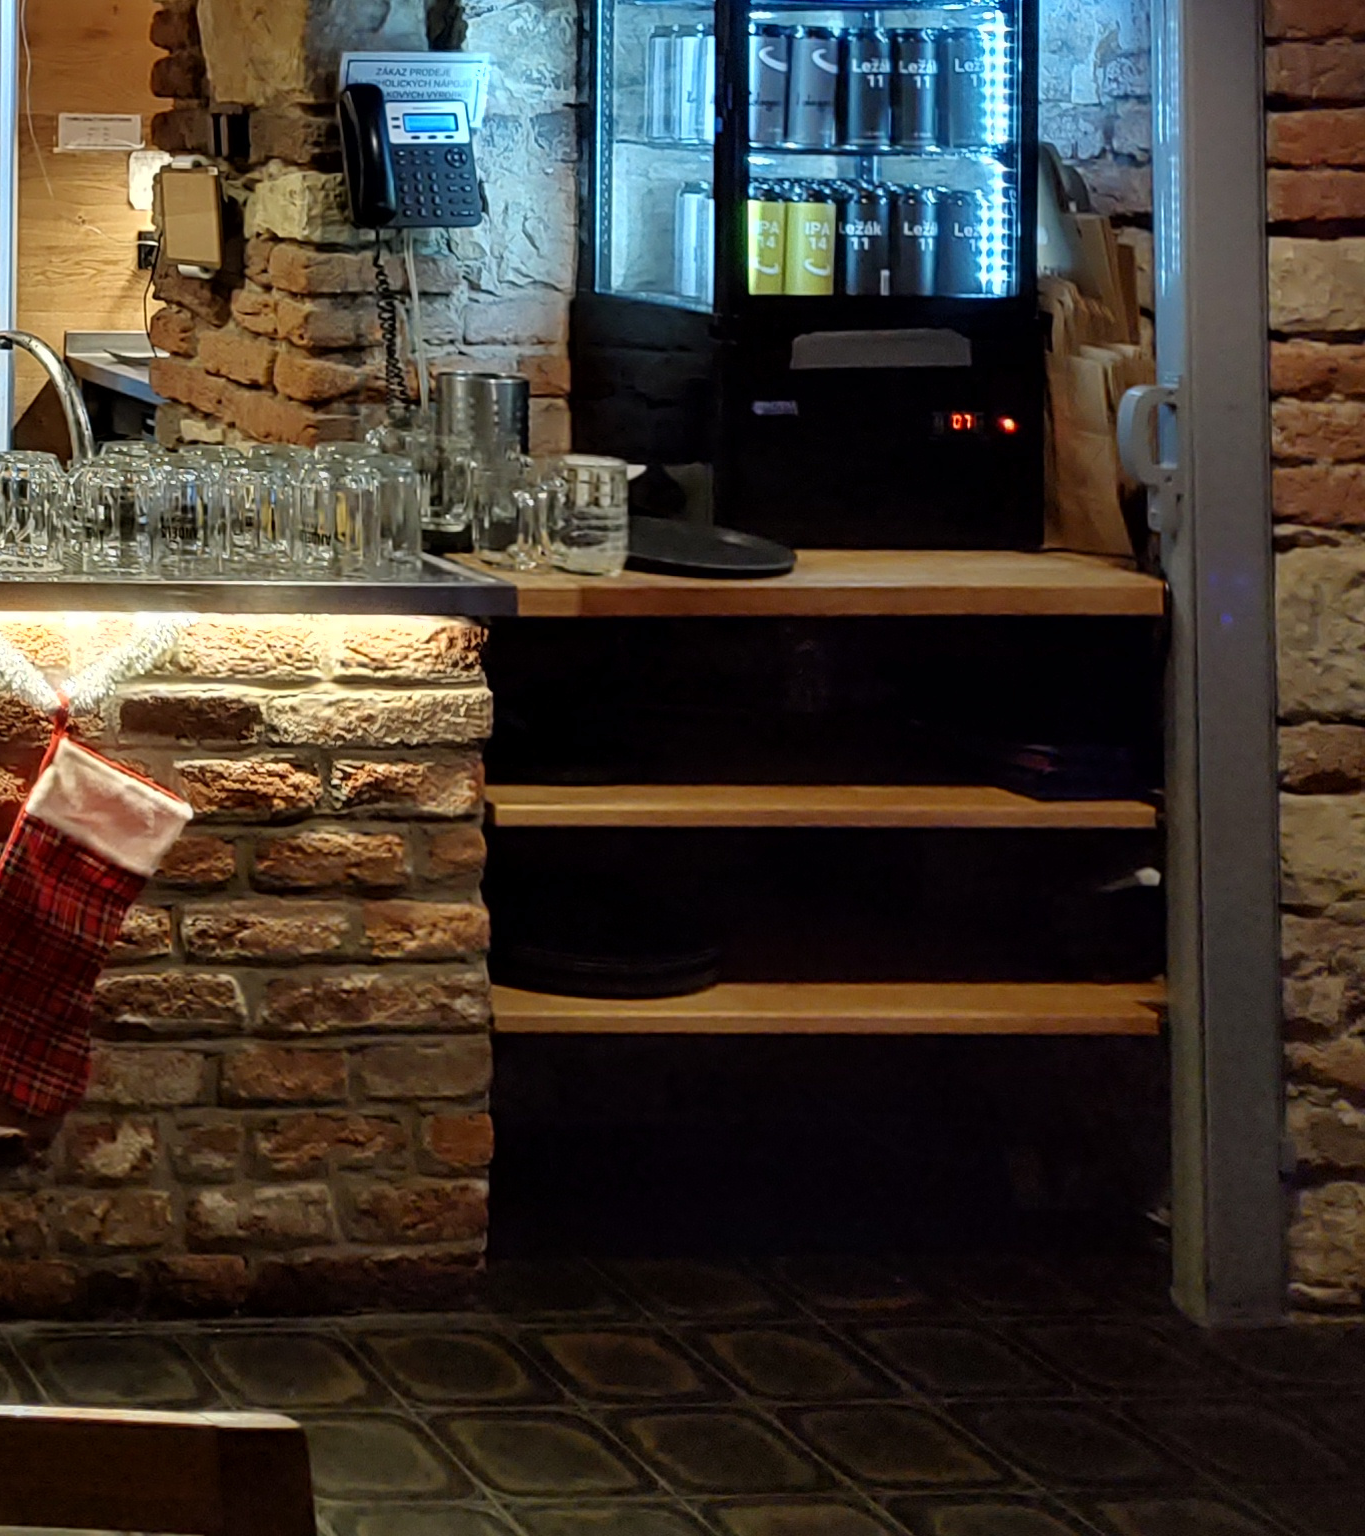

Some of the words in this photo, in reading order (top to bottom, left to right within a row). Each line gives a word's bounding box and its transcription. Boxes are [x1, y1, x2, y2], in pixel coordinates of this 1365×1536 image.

[375, 67, 407, 77] ZÁKAZ
[866, 74, 884, 88] 11
[913, 75, 930, 89] 11
[805, 222, 831, 236] IPA
[839, 219, 883, 236] Ležák
[808, 238, 827, 251] 14
[850, 237, 869, 251] 11
[918, 237, 934, 251] 11
